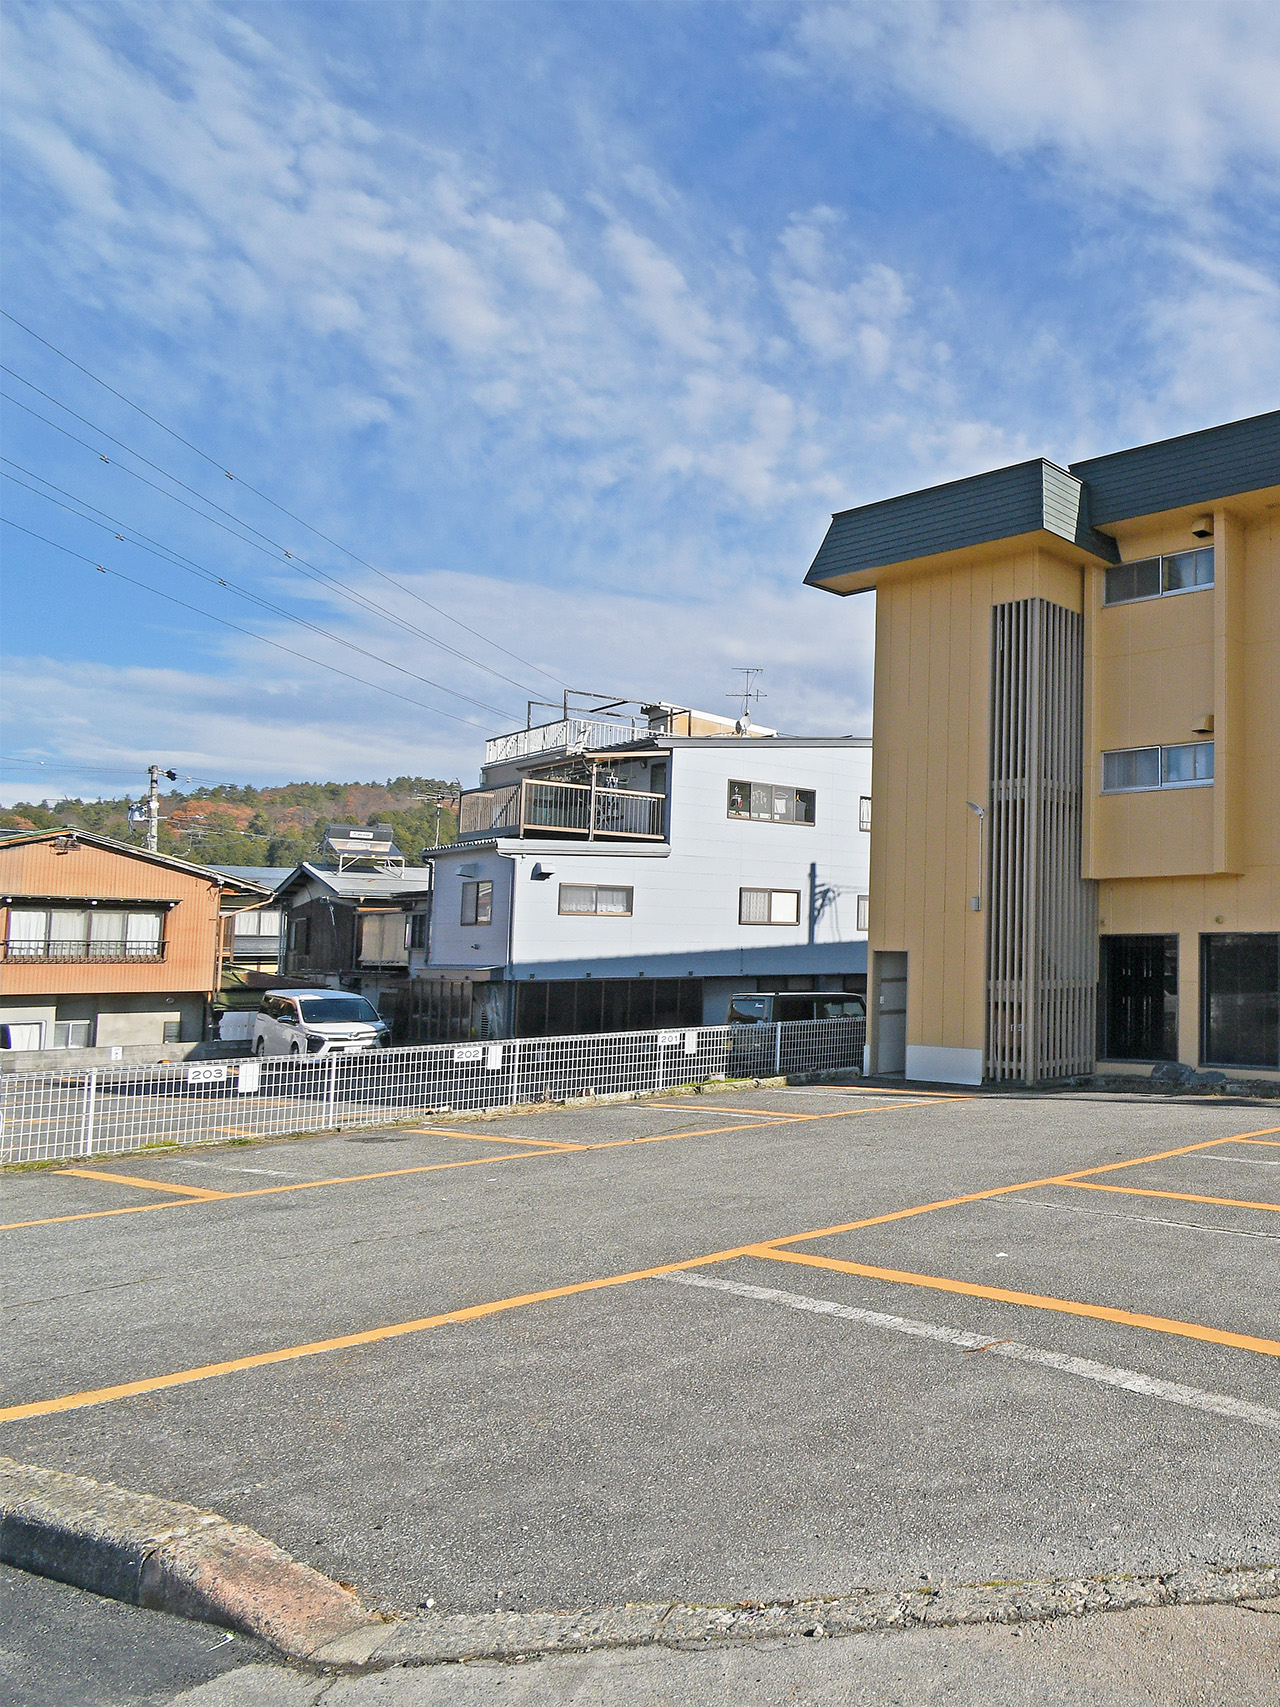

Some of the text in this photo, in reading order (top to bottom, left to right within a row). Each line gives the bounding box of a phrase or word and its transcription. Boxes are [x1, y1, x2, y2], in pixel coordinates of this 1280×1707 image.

[661, 1035, 678, 1043] 201
[457, 1049, 480, 1059] 202
[191, 1068, 223, 1080] 203
